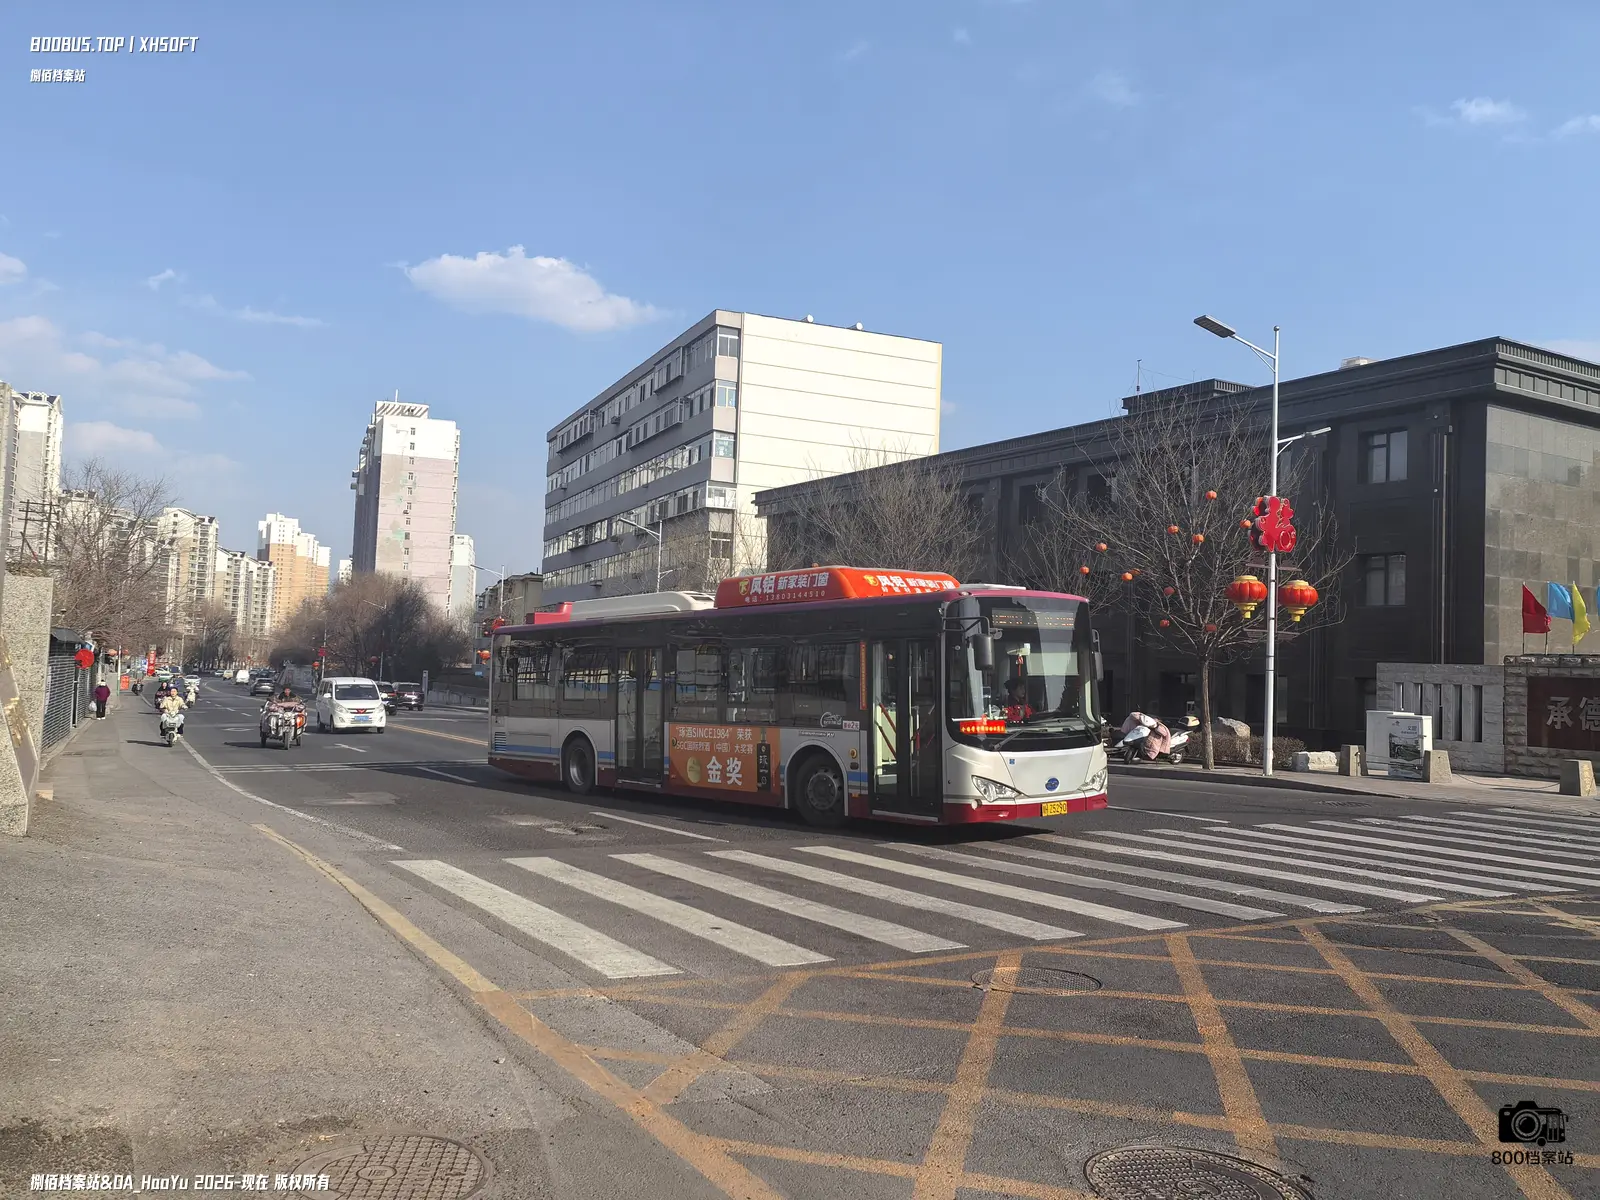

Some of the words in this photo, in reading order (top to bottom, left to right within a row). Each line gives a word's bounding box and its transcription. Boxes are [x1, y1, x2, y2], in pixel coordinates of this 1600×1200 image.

[777, 572, 829, 590] 新家装门窗
[1546, 696, 1600, 732] 承德
[736, 728, 753, 741] 荣获
[706, 755, 743, 786] 金奖
